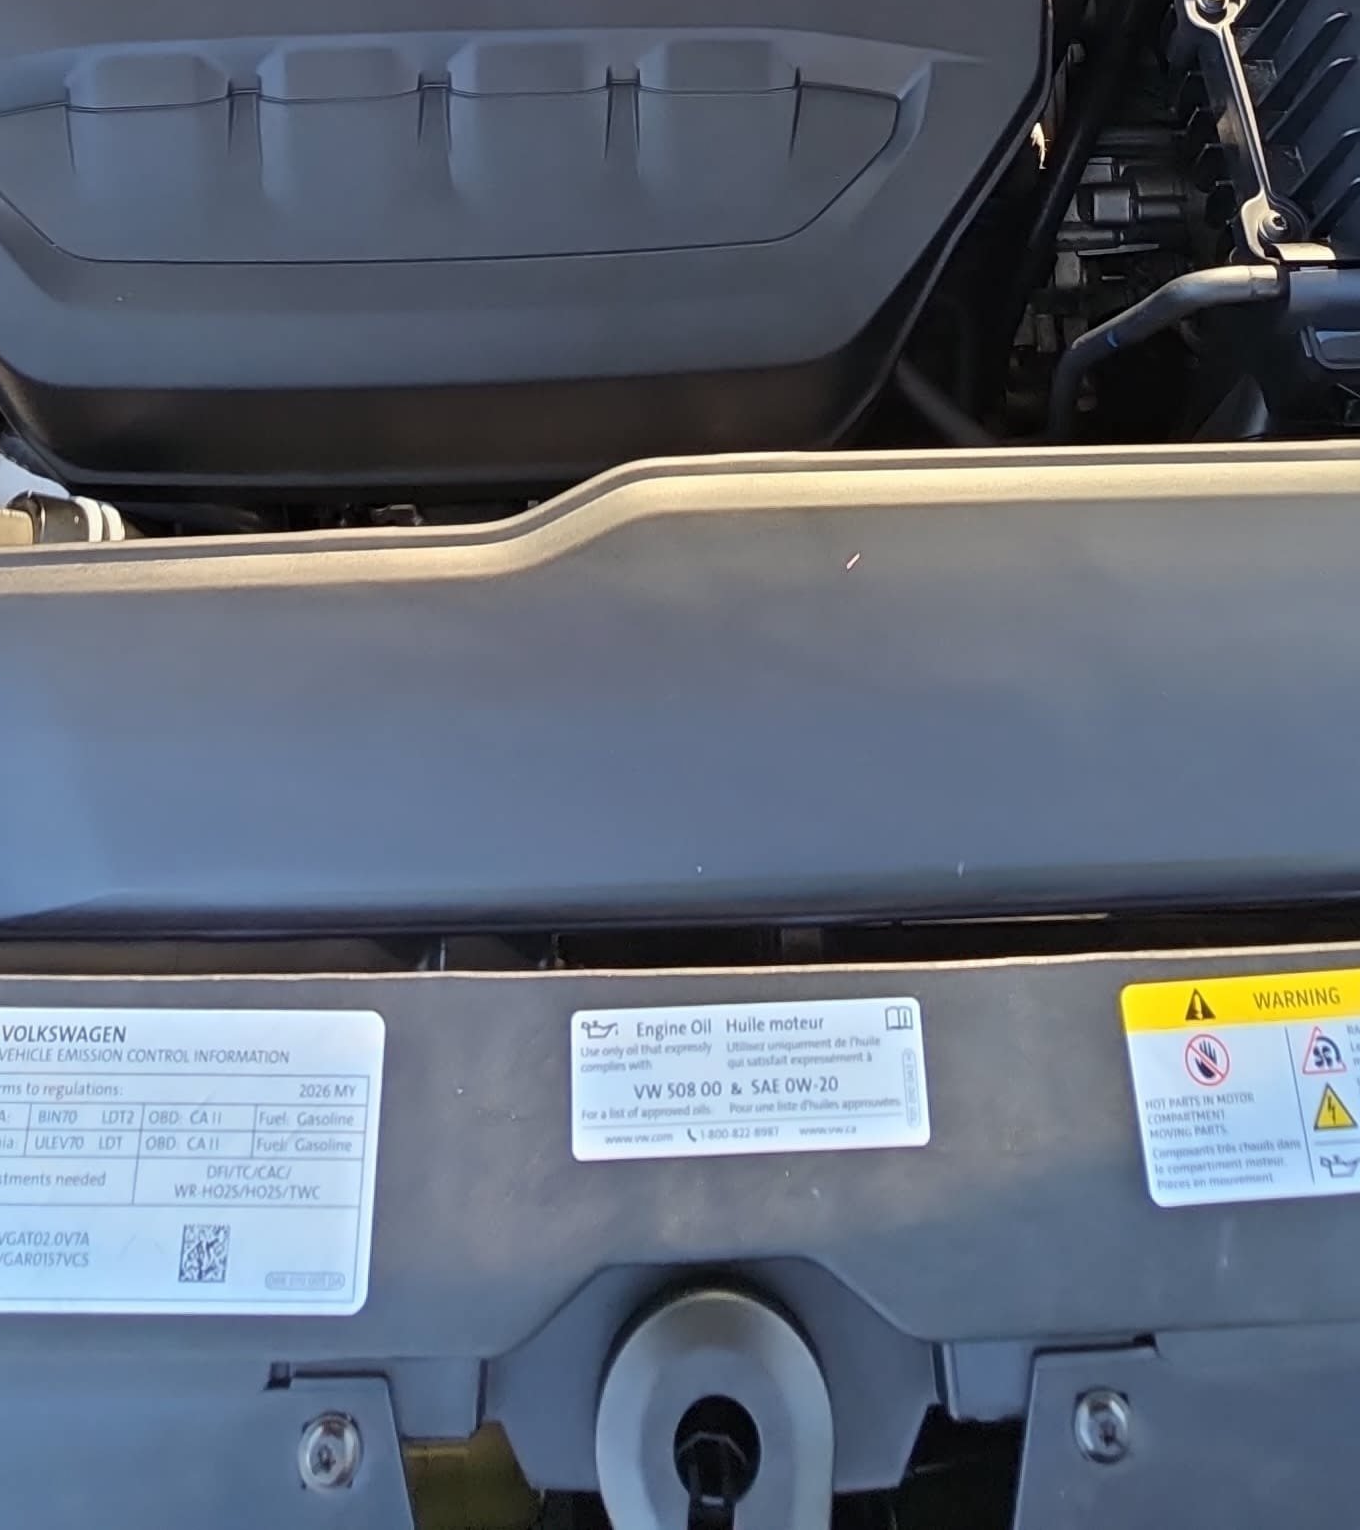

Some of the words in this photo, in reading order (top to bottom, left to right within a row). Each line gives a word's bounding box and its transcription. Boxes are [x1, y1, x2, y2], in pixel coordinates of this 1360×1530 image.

[1252, 985, 1341, 1011] WARNING
[636, 1020, 687, 1041] Engine
[691, 1018, 711, 1035] Oil
[726, 1017, 765, 1032] Huile
[769, 1016, 824, 1031] moteur
[2, 1025, 126, 1043] VOLKSWAGEN
[580, 1047, 600, 1057] Use
[601, 1046, 624, 1059] only
[641, 1043, 662, 1054] that
[665, 1041, 712, 1055] expressly
[767, 1037, 831, 1051] uniquement
[834, 1037, 846, 1048] de
[0, 1048, 52, 1062] VEHICLE
[57, 1048, 122, 1062] EMISSION
[127, 1049, 193, 1064] CONTROL
[194, 1050, 290, 1064] INFORMATION
[727, 1057, 744, 1069] qui
[580, 1061, 626, 1074] complies
[628, 1060, 652, 1070] with
[26, 1082, 39, 1096] to
[43, 1081, 123, 1099] regulations:
[299, 1084, 330, 1098] 2026
[334, 1084, 356, 1098] MY
[633, 1083, 662, 1099] VW
[667, 1081, 696, 1099] 508
[700, 1080, 722, 1097] 00
[731, 1082, 742, 1095] &
[751, 1077, 781, 1094] SAE
[785, 1075, 839, 1093] 0W-20
[729, 1101, 752, 1113] Pour
[755, 1102, 774, 1112] une
[777, 1101, 798, 1111] liste
[1145, 1099, 1166, 1110] HOT
[1169, 1095, 1200, 1108] PARTS
[1203, 1095, 1215, 1105] IN
[1216, 1092, 1255, 1105] MOTOR
[39, 1110, 78, 1124] BIN70
[102, 1110, 134, 1125] LDT2
[190, 1111, 208, 1124] CA
[296, 1111, 354, 1126] Gasoline
[581, 1109, 598, 1120] For
[600, 1110, 607, 1119] a
[609, 1107, 624, 1119] list
[627, 1107, 639, 1118] of
[641, 1105, 690, 1121] approved
[1147, 1110, 1225, 1125] COMPARTMENT
[605, 1133, 673, 1145] www.vw.com
[1150, 1127, 1193, 1140] MOVING
[35, 1136, 84, 1150] ULEV70
[99, 1136, 122, 1150] LDT
[187, 1136, 206, 1151] CA
[295, 1138, 352, 1152] Gasoline
[56, 1171, 106, 1186] needed
[207, 1165, 292, 1179] DFI/TC/CAC/
